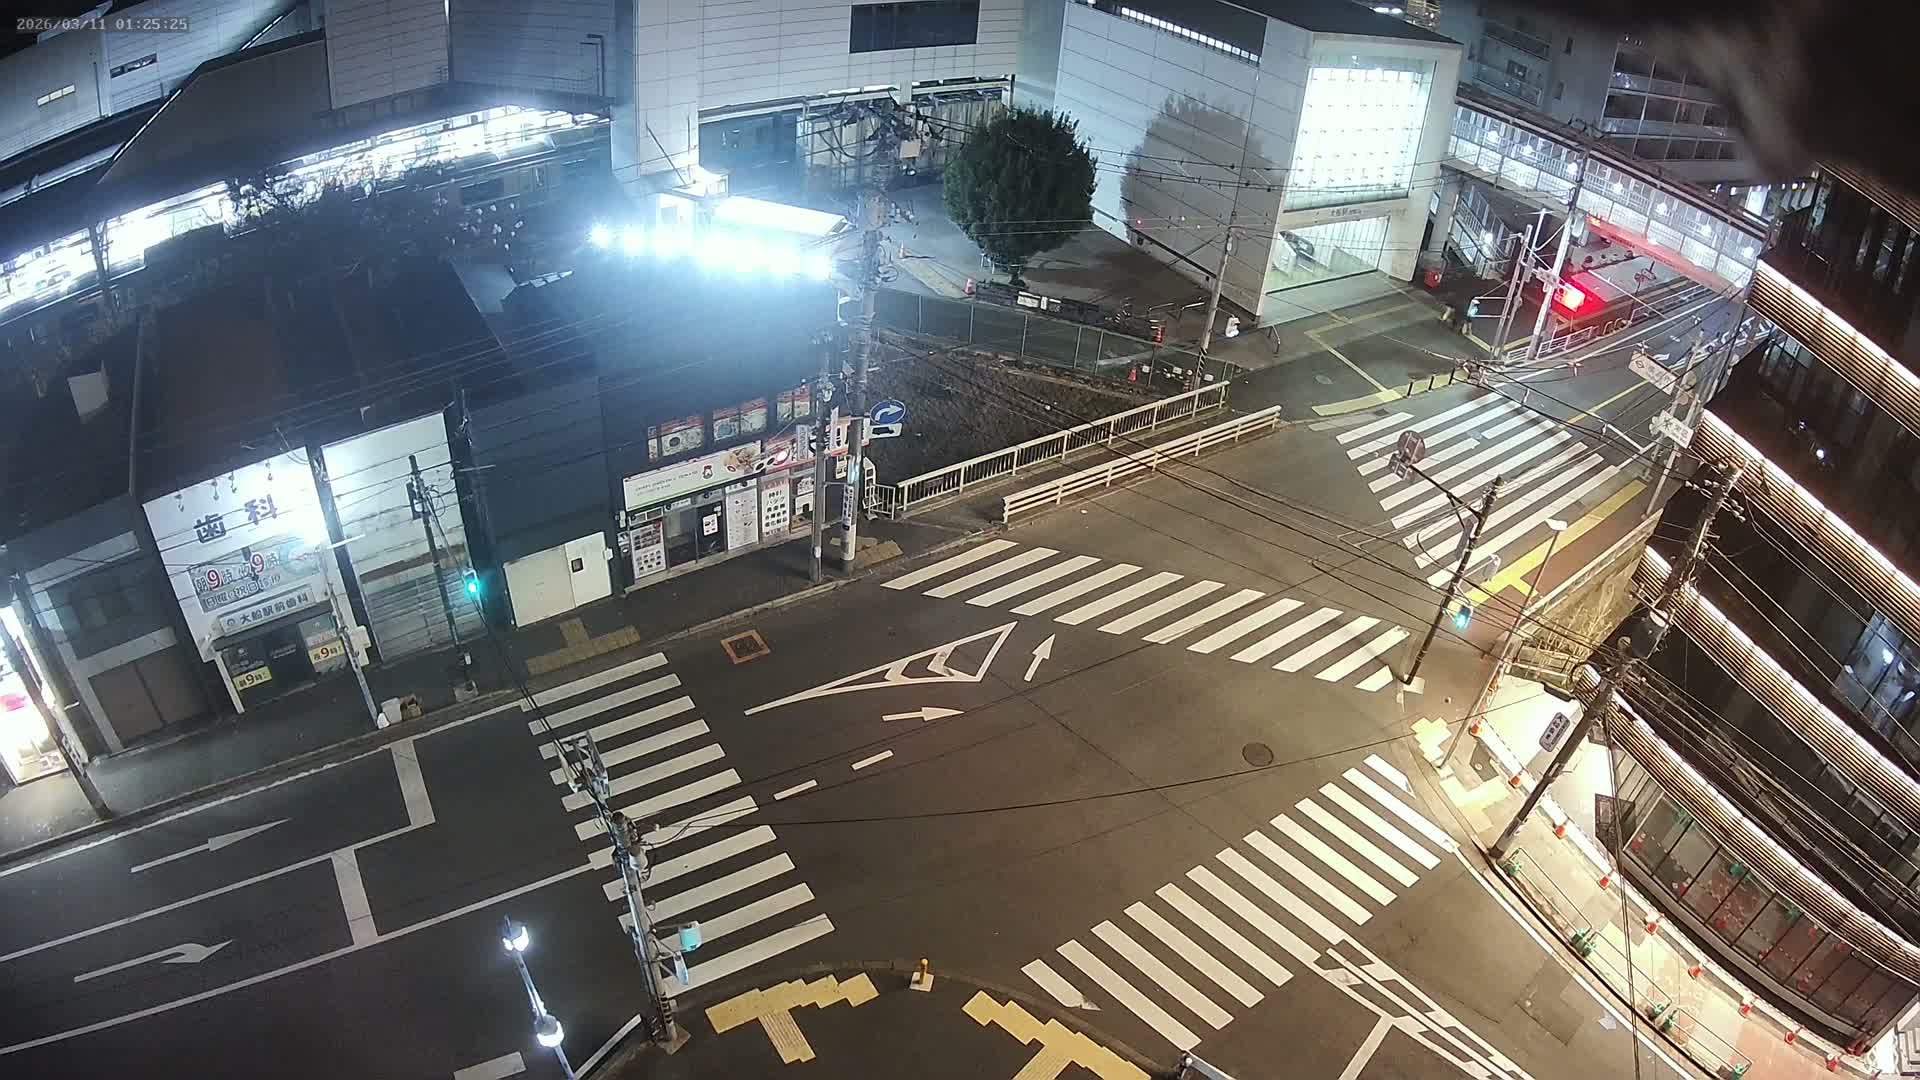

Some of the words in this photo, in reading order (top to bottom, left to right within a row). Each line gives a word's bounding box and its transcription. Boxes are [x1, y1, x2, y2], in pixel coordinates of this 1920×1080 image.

[194, 494, 277, 544] 歯科
[240, 592, 309, 625] 大船駅前歯科
